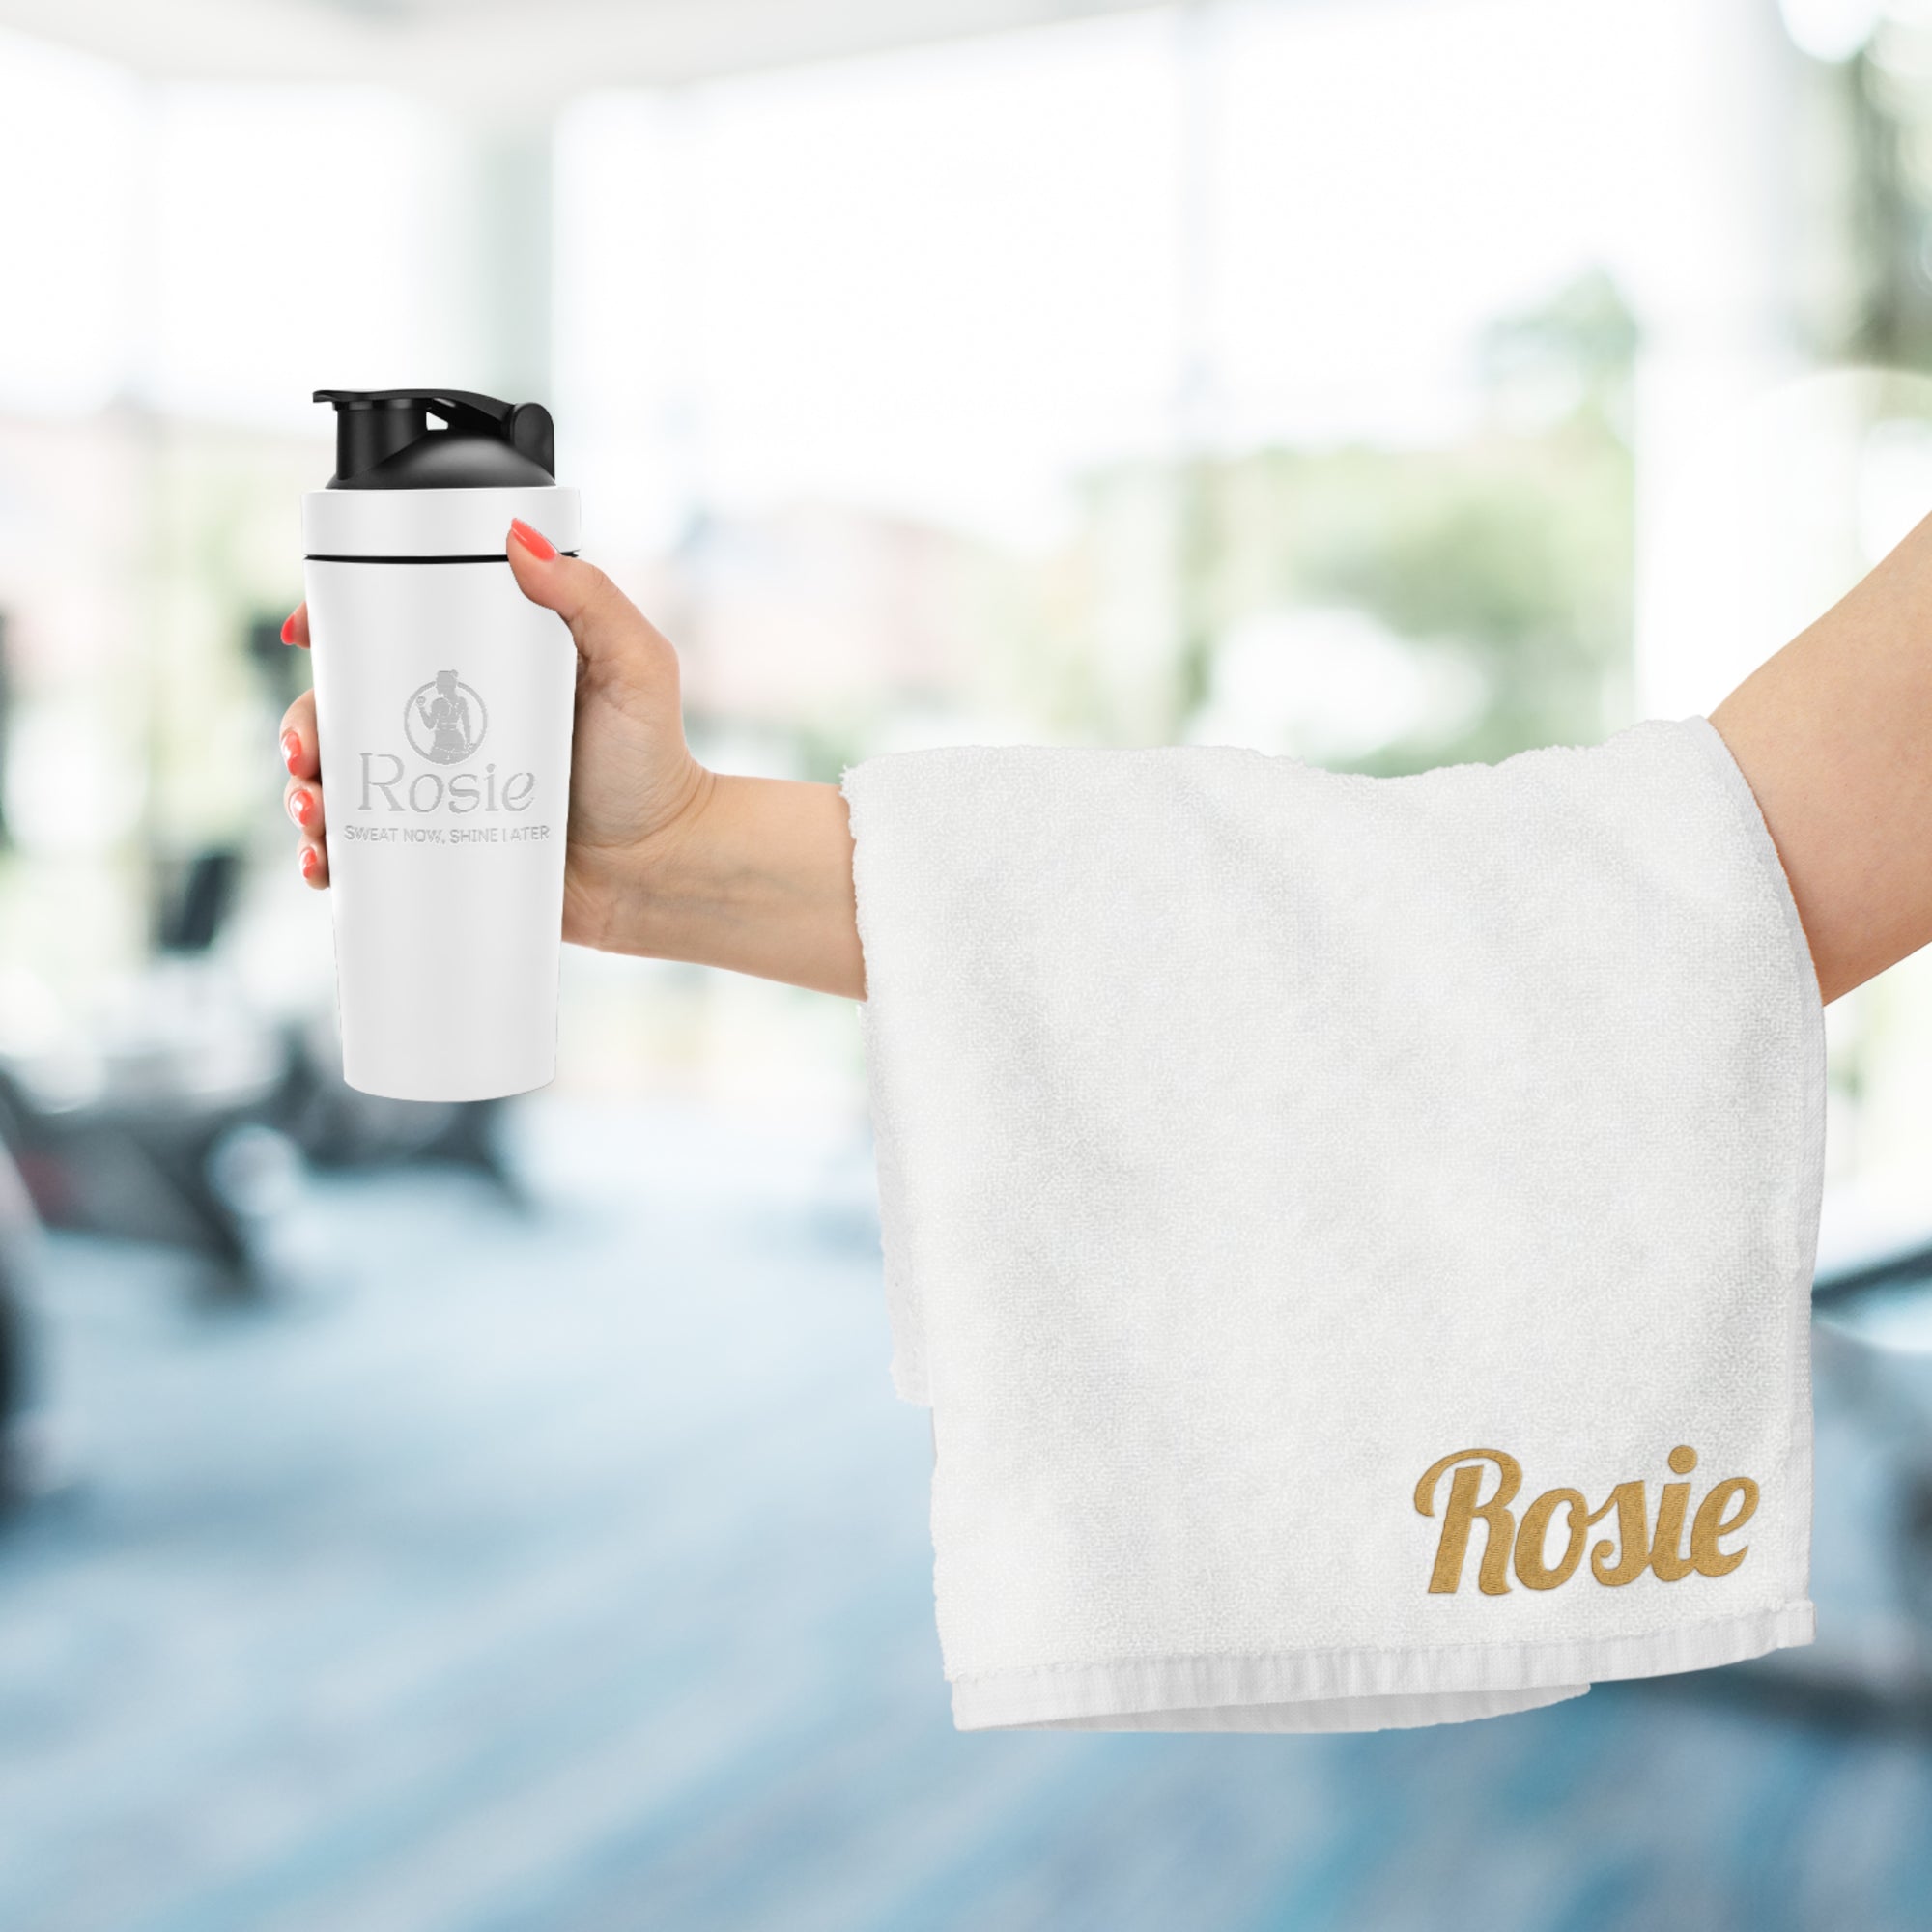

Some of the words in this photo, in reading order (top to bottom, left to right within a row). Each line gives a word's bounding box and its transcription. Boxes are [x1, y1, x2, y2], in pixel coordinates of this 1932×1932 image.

[358, 753, 535, 813] Rosie
[344, 825, 399, 842] SWEAT
[449, 828, 498, 844] SHINE
[1414, 1445, 1759, 1596] Rosie
